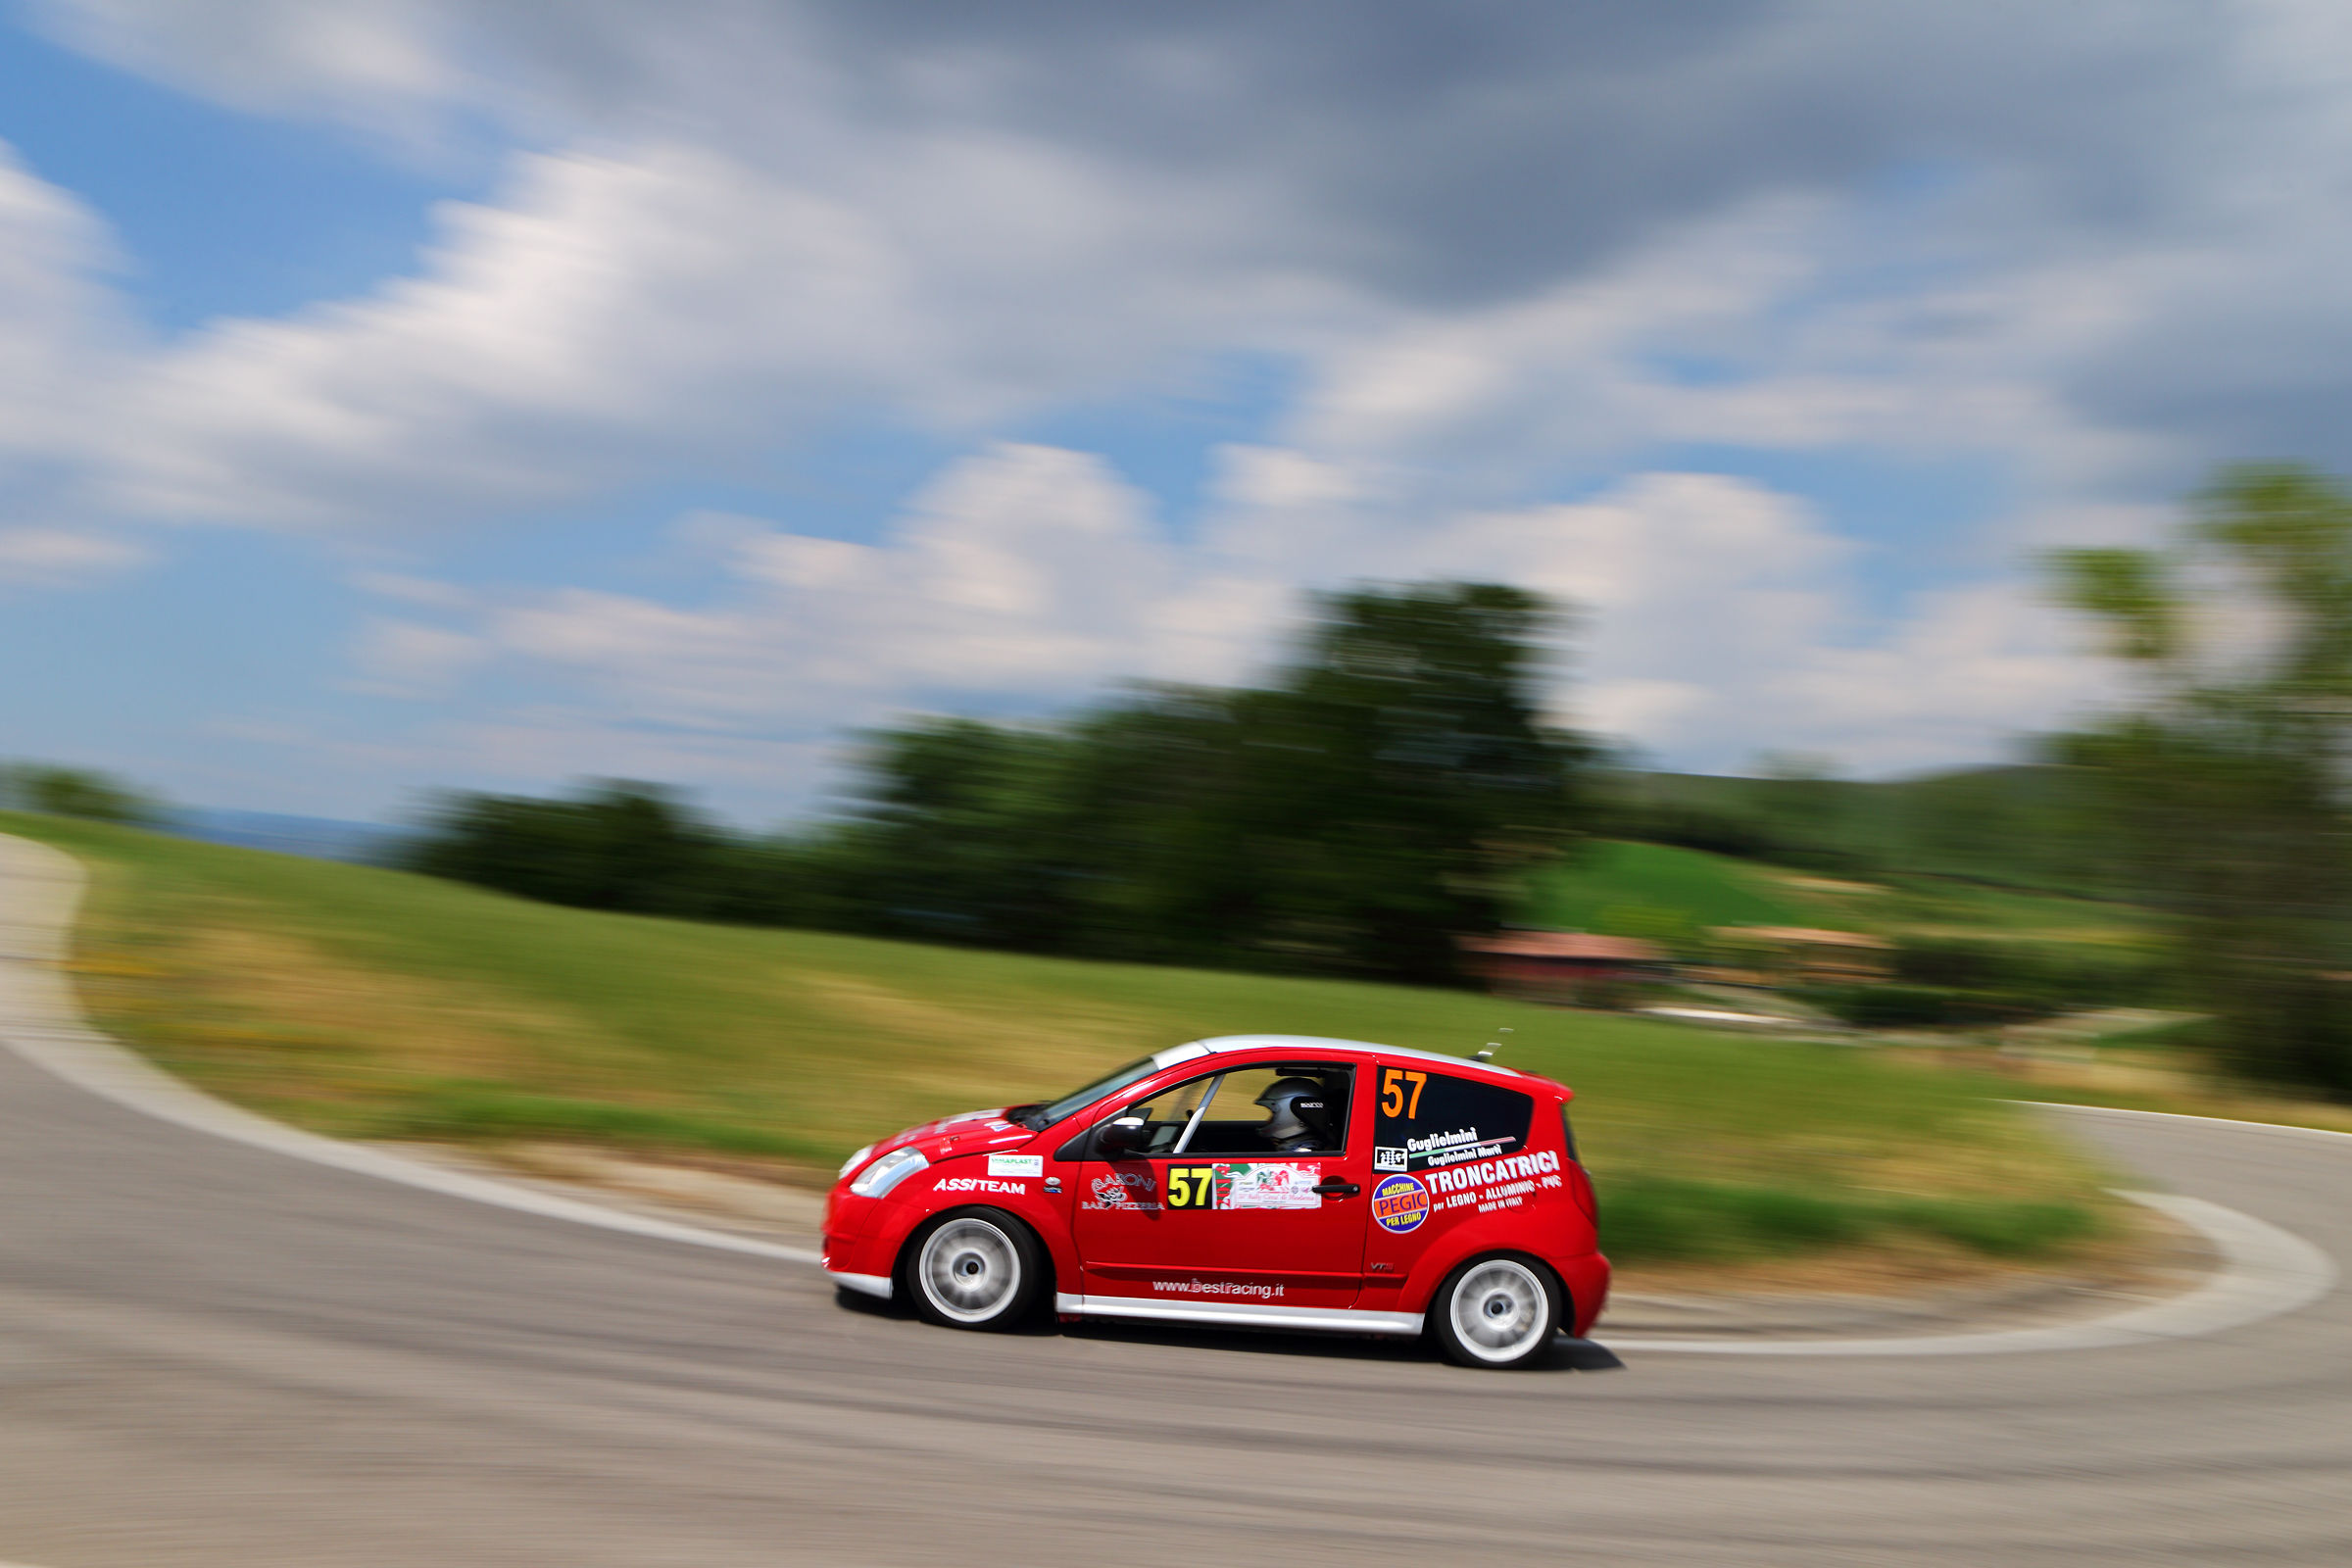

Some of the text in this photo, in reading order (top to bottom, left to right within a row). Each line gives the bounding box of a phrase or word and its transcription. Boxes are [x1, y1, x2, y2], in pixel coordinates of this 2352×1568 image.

[1382, 1068, 1427, 1119] 57
[1407, 1127, 1478, 1152] Guglielmini
[1427, 1148, 1477, 1166] Guglielmini
[1425, 1151, 1560, 1194] TRONCATRICI
[933, 1178, 1026, 1195] ASSITEAM
[1168, 1168, 1212, 1206] 57
[1382, 1182, 1415, 1197] MACCHINE
[1433, 1201, 1445, 1212] per
[1446, 1192, 1477, 1208] LEGNO
[1486, 1179, 1536, 1200] ALLUMINIO
[1542, 1174, 1563, 1189] PVC
[1115, 1201, 1165, 1210] PIZZERIA
[1478, 1196, 1523, 1213] MADE IN ITALY
[1386, 1211, 1422, 1227] PER LEGNO
[1152, 1278, 1285, 1299] www.bestracing.it
